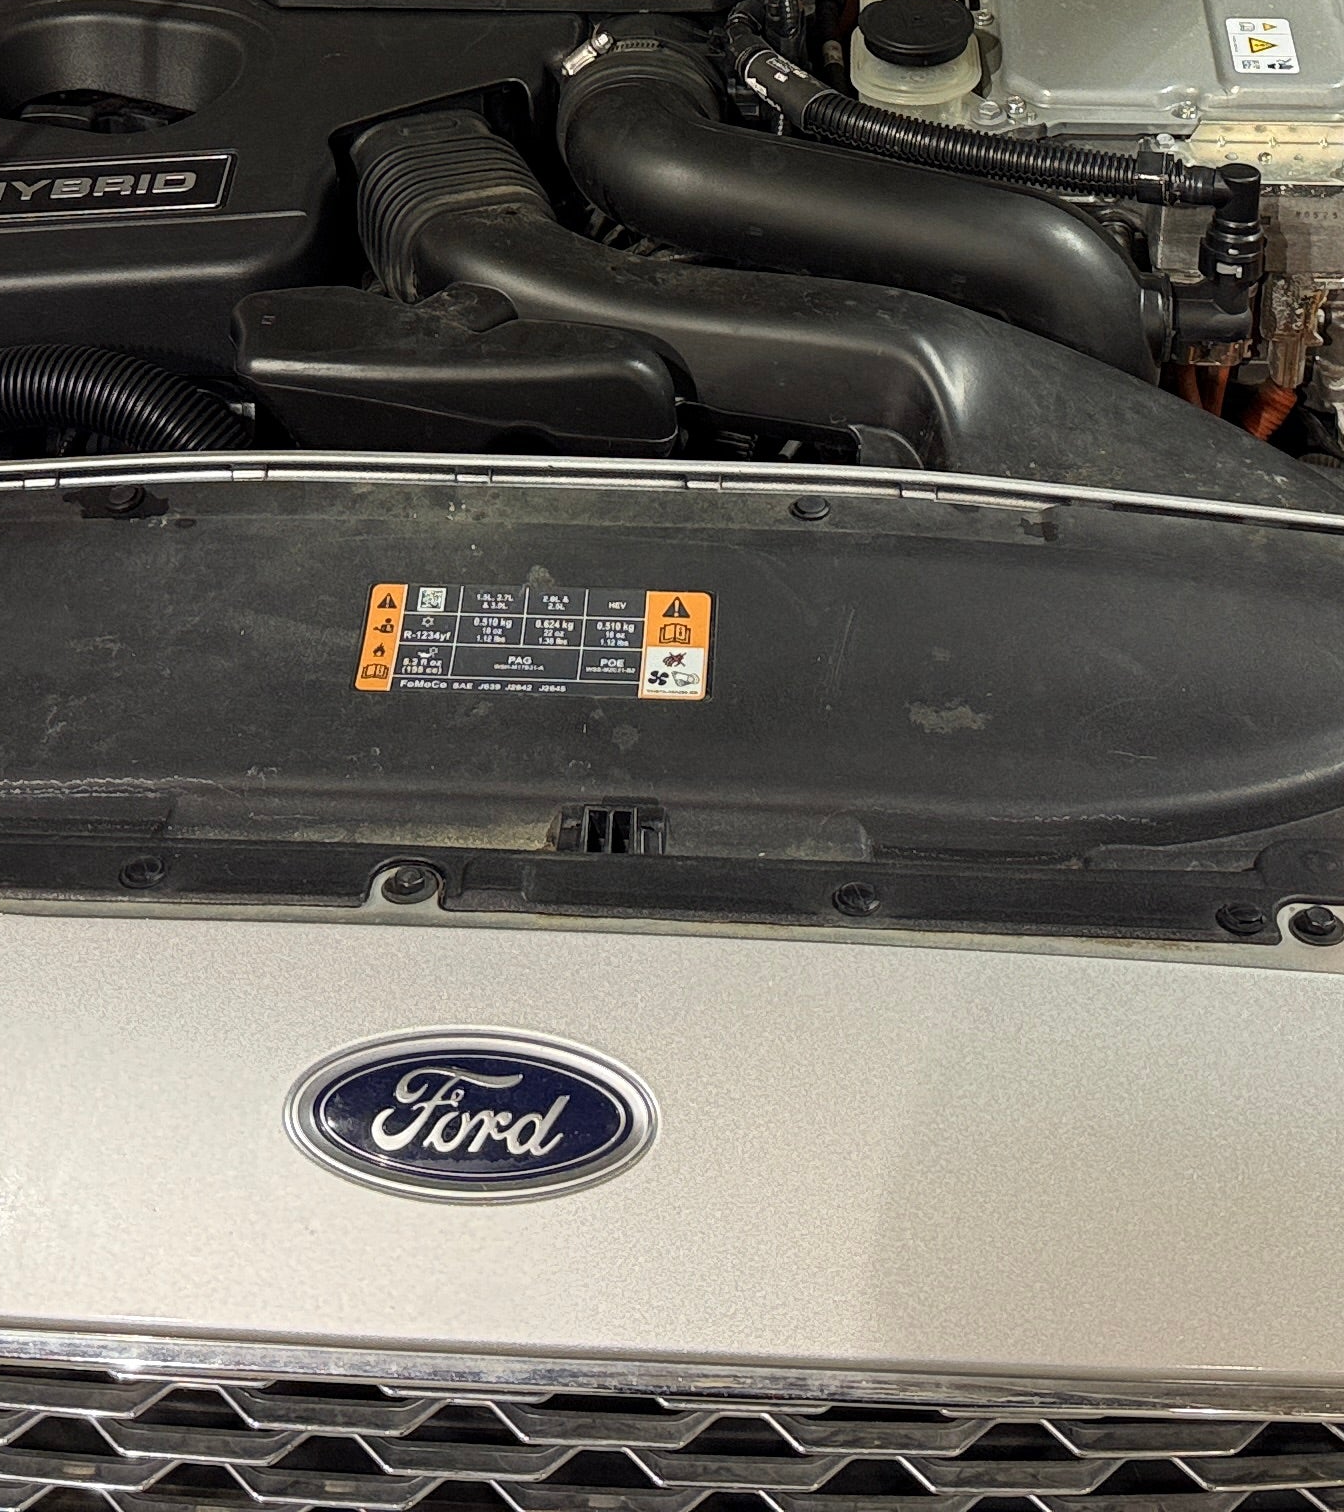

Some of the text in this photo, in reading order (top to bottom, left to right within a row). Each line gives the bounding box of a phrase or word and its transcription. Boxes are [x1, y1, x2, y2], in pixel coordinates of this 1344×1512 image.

[474, 617, 512, 629] 0.510 kg
[535, 620, 574, 631] 0.624 kg
[597, 622, 635, 633] 0.510 kg
[403, 630, 451, 641] R-1234yf
[508, 656, 532, 664] PAG
[600, 659, 625, 668] POE
[400, 679, 447, 688] FoMoCo
[370, 1066, 571, 1157] Ford
